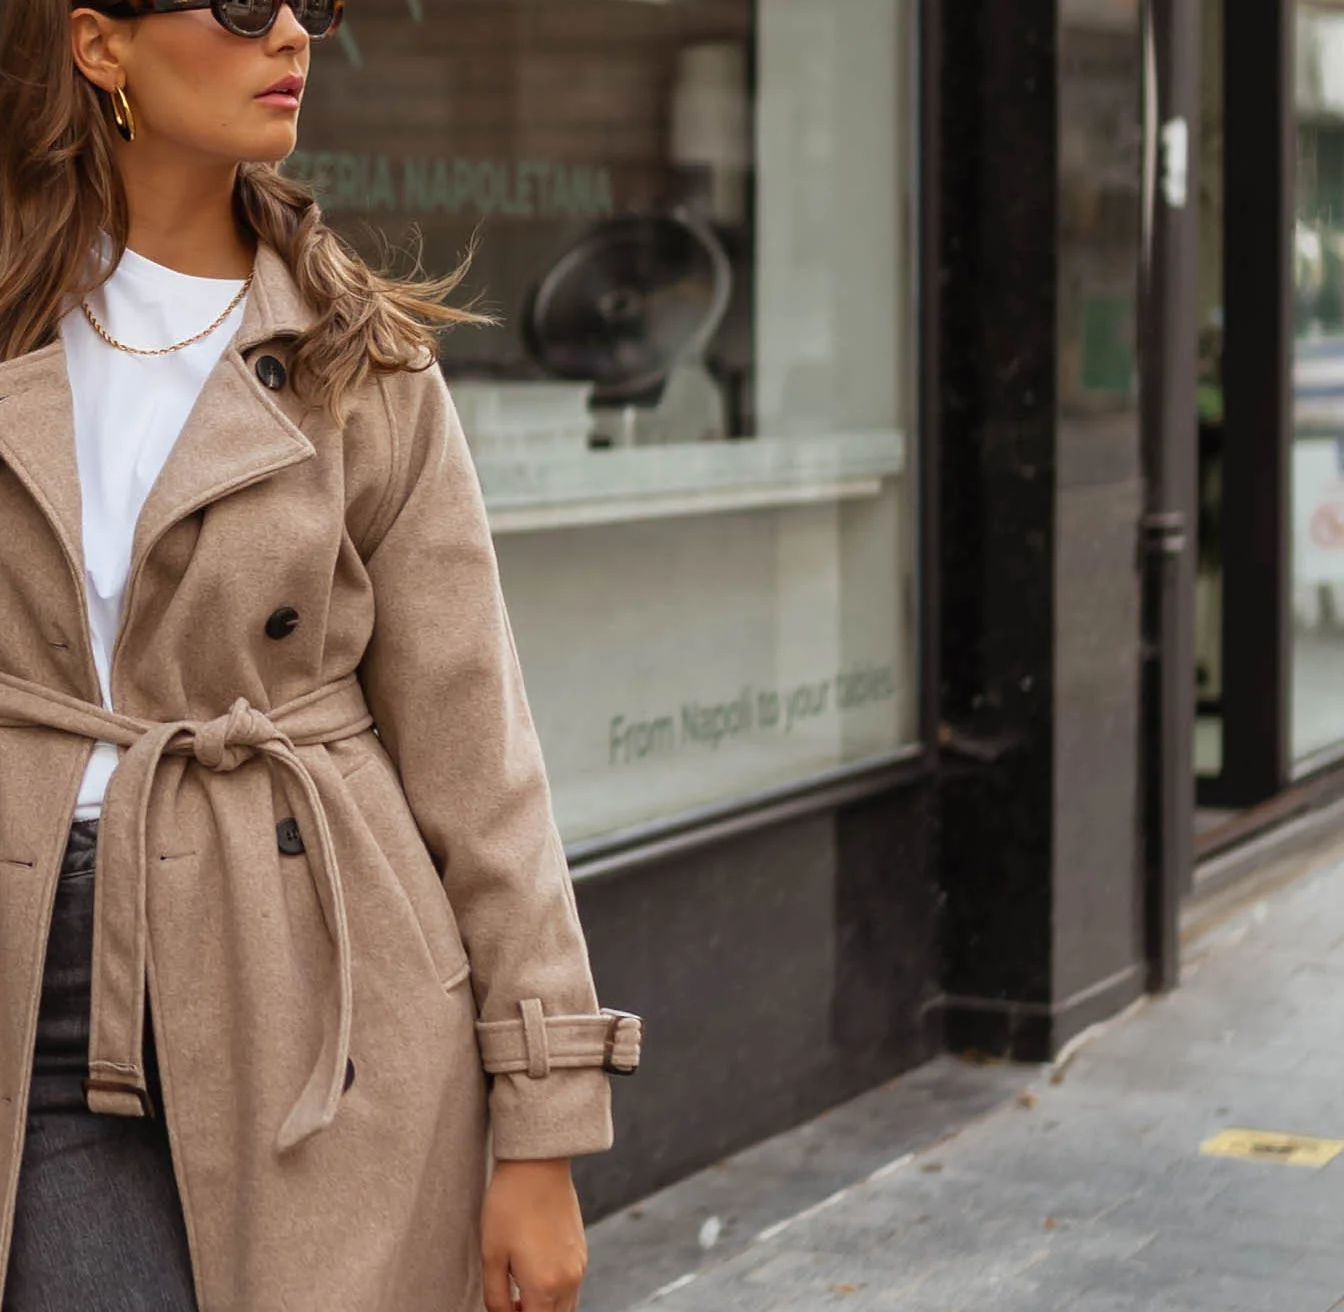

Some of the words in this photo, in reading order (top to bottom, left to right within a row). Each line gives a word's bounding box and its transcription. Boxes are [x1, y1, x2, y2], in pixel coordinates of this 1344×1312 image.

[404, 156, 613, 215] NAPOLETANA
[608, 714, 674, 766] From
[679, 686, 752, 750] Napoli
[757, 688, 781, 730] to
[785, 679, 830, 736] your
